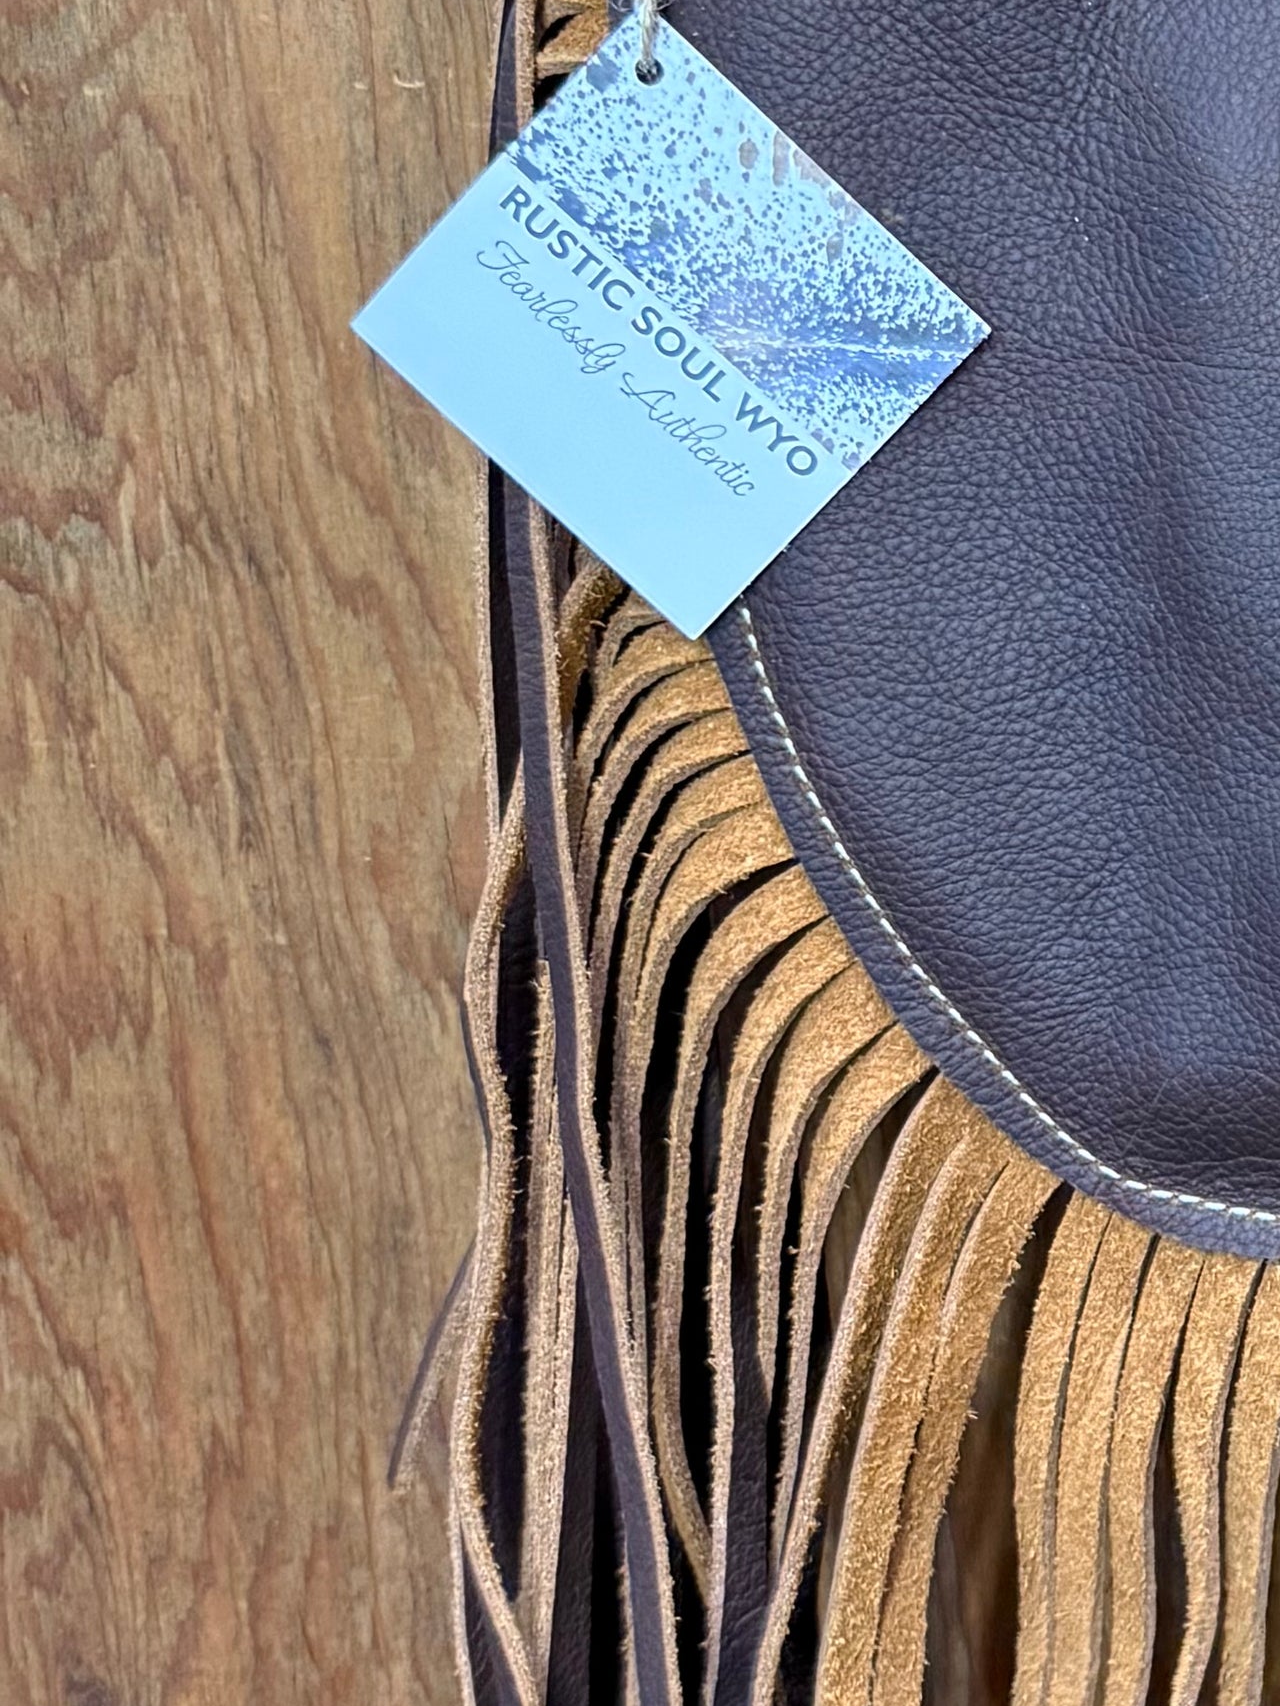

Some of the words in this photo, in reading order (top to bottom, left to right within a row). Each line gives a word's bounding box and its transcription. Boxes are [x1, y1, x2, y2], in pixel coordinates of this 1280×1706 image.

[476, 239, 626, 374] Fearlessly
[619, 371, 756, 497] Authentic
[499, 184, 636, 311] RUSTIC
[631, 305, 723, 402] SOUL
[733, 393, 819, 477] WYO
